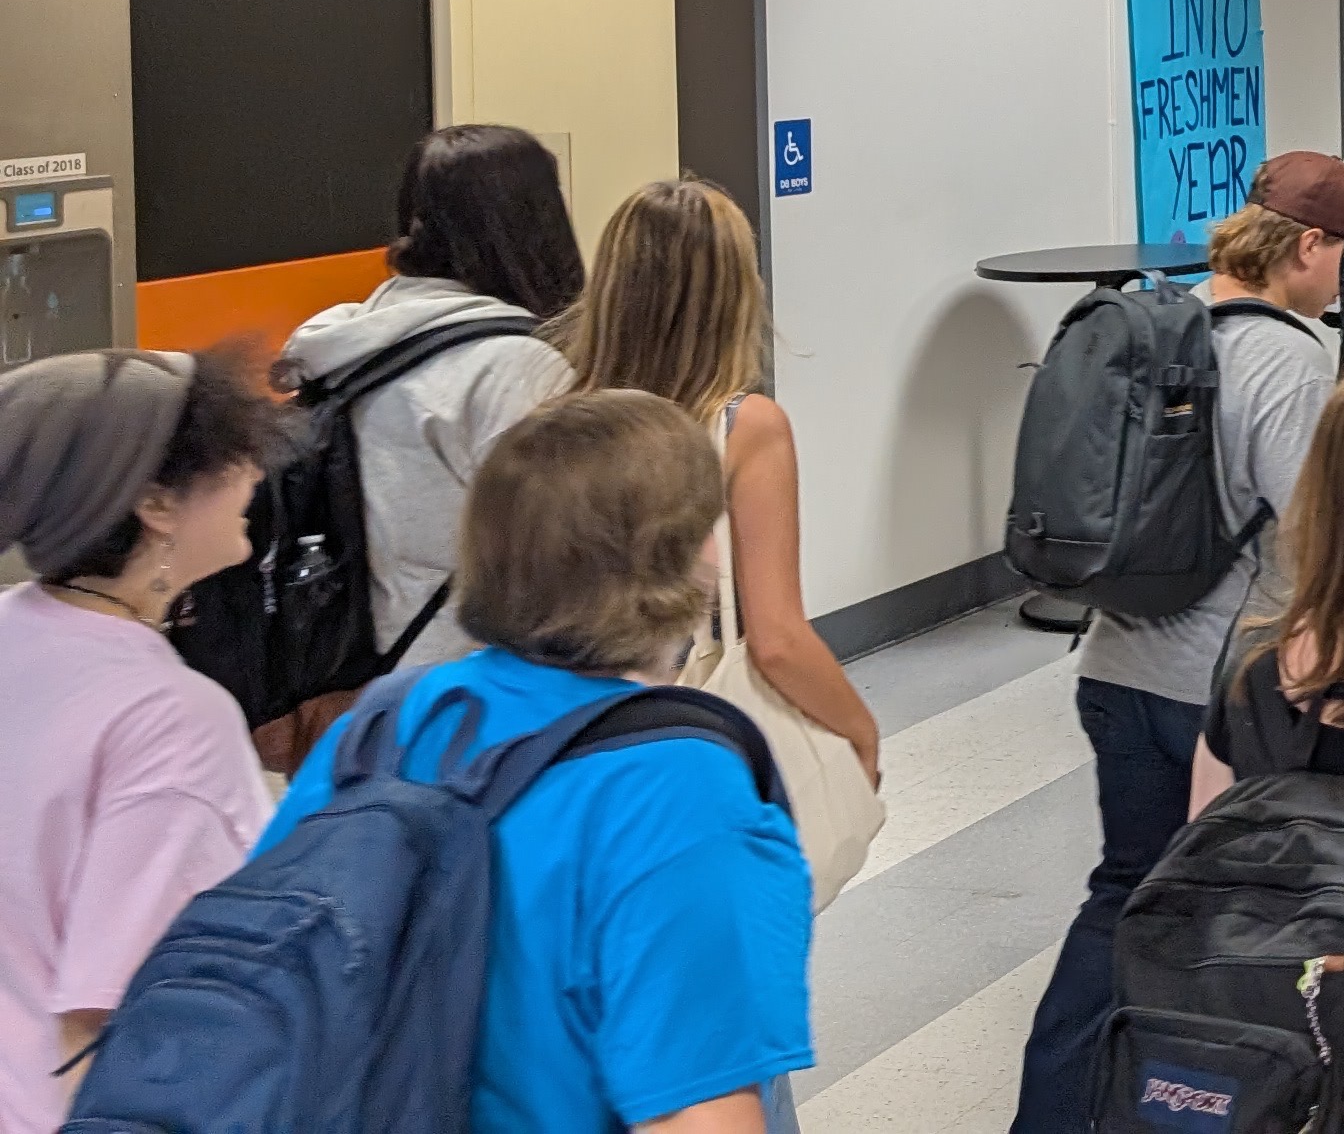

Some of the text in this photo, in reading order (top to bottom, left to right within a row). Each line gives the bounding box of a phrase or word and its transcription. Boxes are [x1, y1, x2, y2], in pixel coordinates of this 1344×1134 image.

[1140, 66, 1260, 140] FRESHMEN
[4, 158, 82, 178] Class of 2018
[1169, 134, 1249, 222] YEAR
